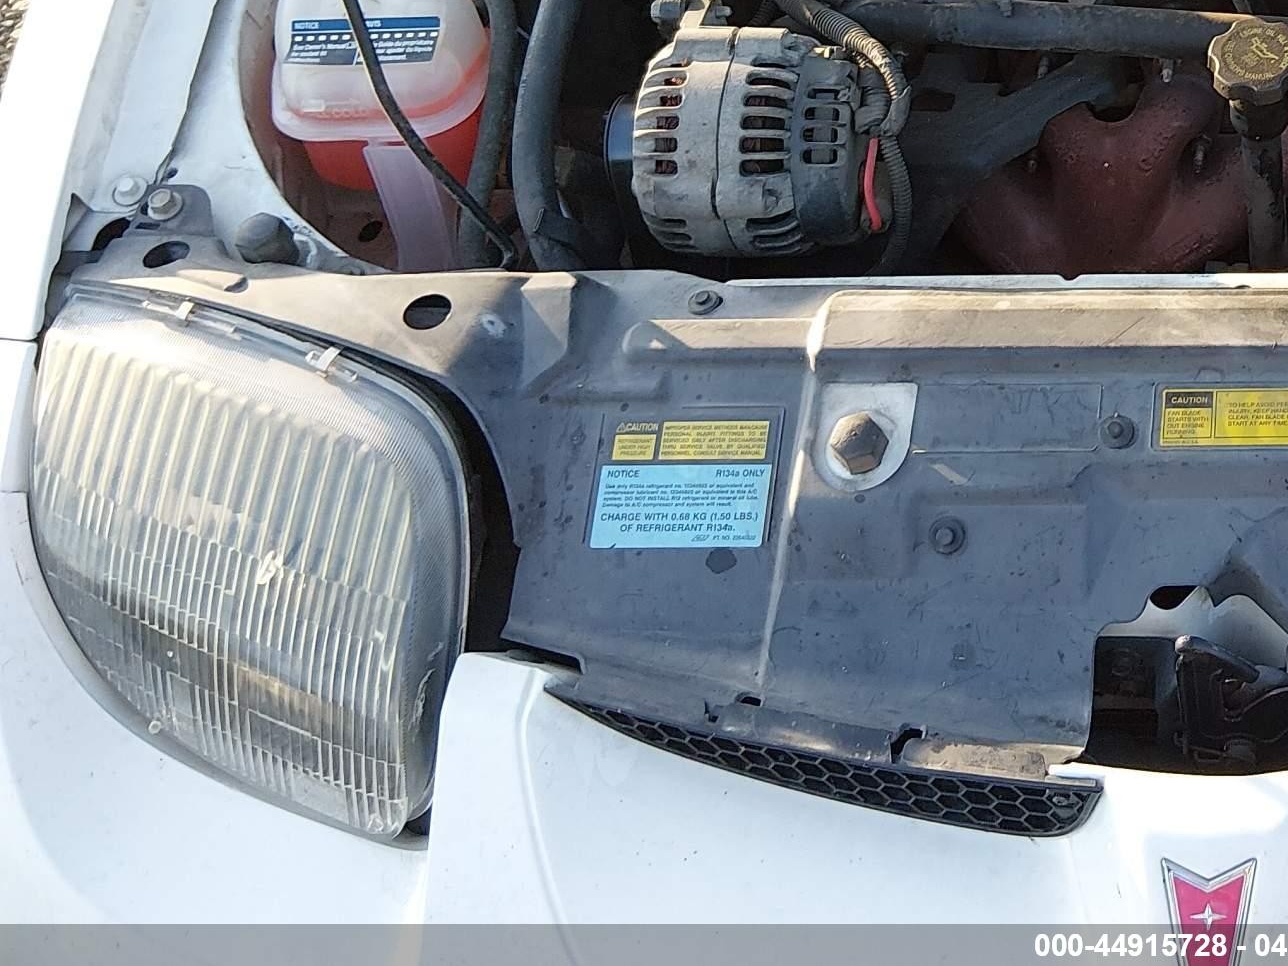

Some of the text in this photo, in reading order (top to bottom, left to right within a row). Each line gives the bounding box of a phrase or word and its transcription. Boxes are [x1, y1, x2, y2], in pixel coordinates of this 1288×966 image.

[1171, 396, 1208, 404] CAUTION
[625, 423, 658, 432] CAUTION
[607, 469, 765, 478] NOTICE R134a ONLY
[601, 513, 641, 521] CHARGE
[710, 513, 731, 521] (1.50
[734, 513, 758, 521] LBS.)
[620, 524, 633, 532] OF
[636, 524, 703, 532] REFRIGERANT
